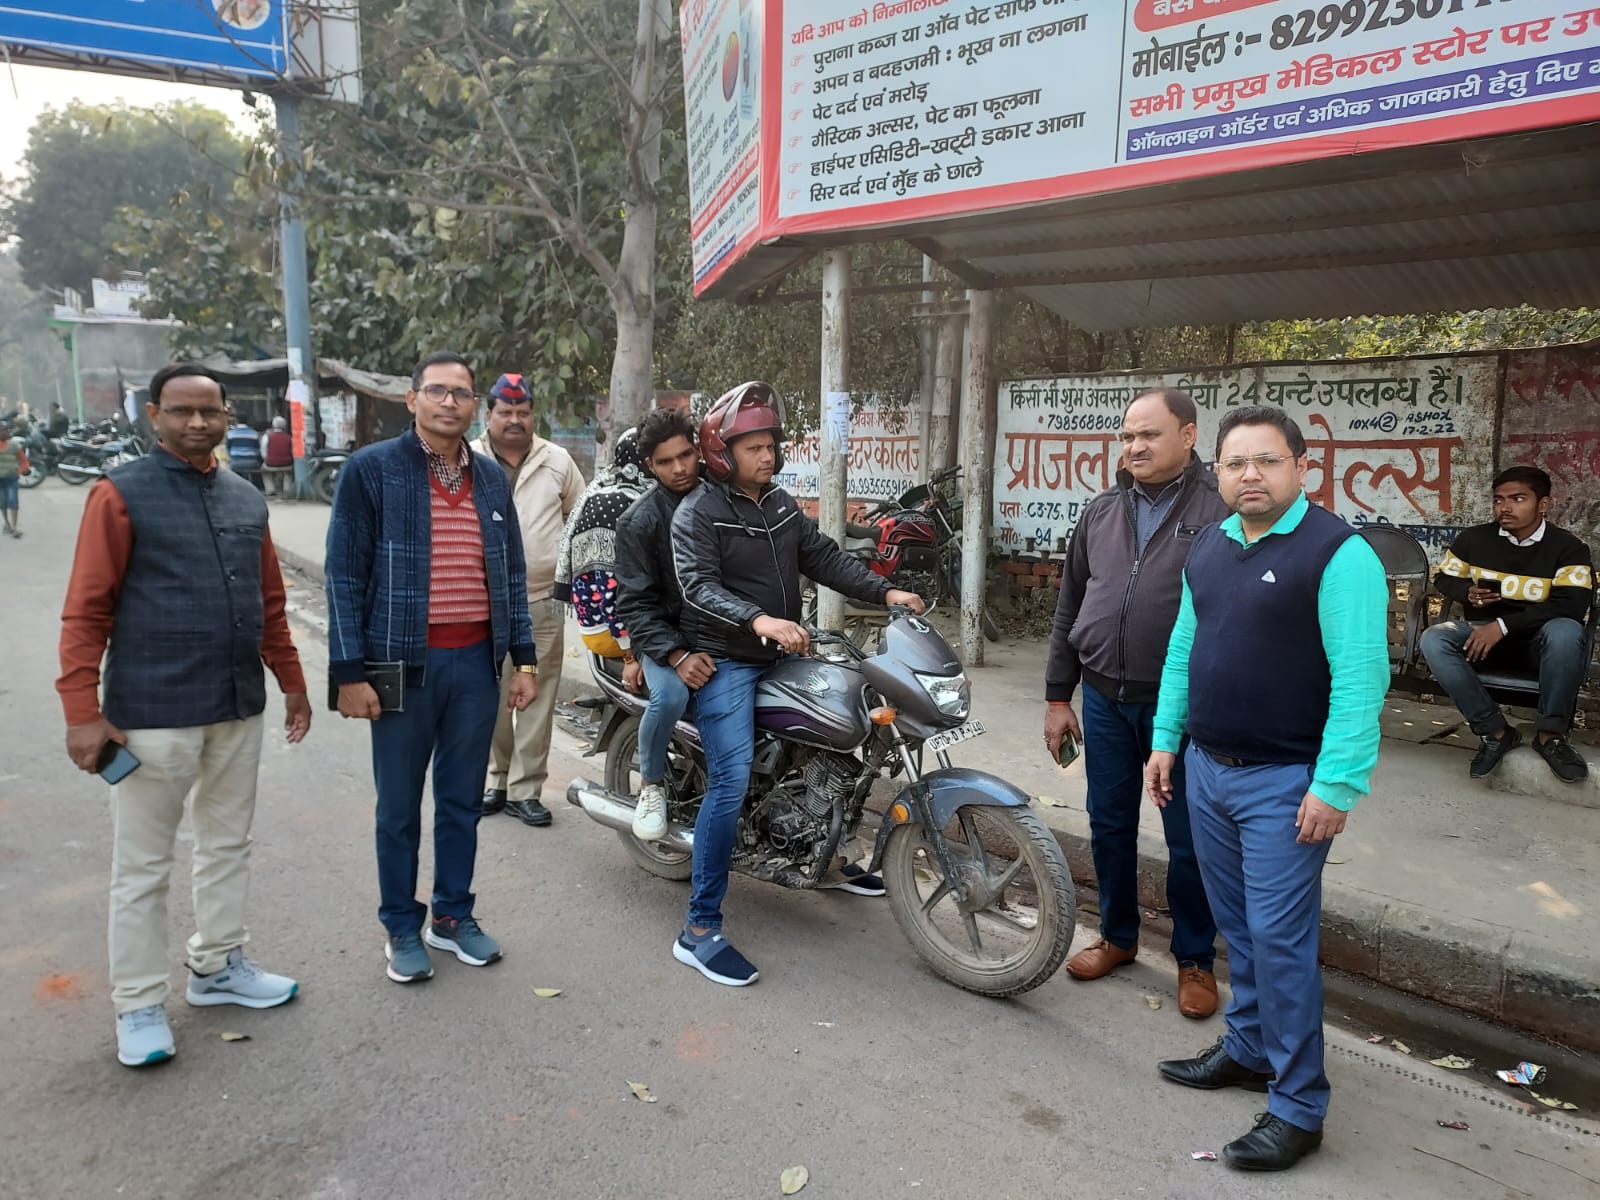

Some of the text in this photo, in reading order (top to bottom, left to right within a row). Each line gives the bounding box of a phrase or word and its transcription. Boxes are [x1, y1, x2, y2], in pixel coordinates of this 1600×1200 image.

[791, 23, 815, 45] यदि
[818, 18, 845, 38] आप
[849, 8, 867, 28] को
[813, 43, 854, 74] पुराना
[858, 32, 897, 54] कब्ज
[902, 25, 921, 43] या
[965, 6, 991, 26] पेट
[813, 72, 850, 95] अपच
[853, 69, 865, 83] व
[868, 45, 942, 80] बदहजमी
[957, 36, 995, 66] भूख
[999, 30, 1022, 48] ना
[1026, 13, 1088, 44] लगना
[1132, 23, 1230, 78] मोबाईल
[1129, 82, 1186, 118] सभी
[1191, 73, 1270, 112] प्रमुख
[1276, 46, 1407, 90] मेडिकल
[1412, 26, 1494, 66] स्टोर
[1500, 16, 1556, 46] पर
[812, 80, 930, 121] पेट दर्द एवं मरोड़
[925, 105, 950, 125] पेट
[953, 101, 978, 119] का
[983, 88, 1042, 120] फूलना
[1130, 126, 1217, 151] ऑनलाइन
[1218, 112, 1270, 138] ऑर्डर
[1273, 105, 1306, 129] एवं
[1305, 98, 1375, 124] अधिक
[1378, 74, 1483, 112] जानकारी
[1488, 69, 1530, 98] हेतु
[1535, 60, 1583, 86] दिए
[810, 153, 857, 177] हाईपर
[981, 121, 1033, 146] डकार
[1036, 111, 1086, 135] आना
[810, 182, 836, 202] सिर
[839, 175, 863, 197] दर्द
[866, 171, 890, 194] एवं
[923, 162, 942, 183] के
[946, 155, 984, 180] छाले
[1009, 383, 1042, 410] किसी
[1226, 381, 1261, 407] 24
[1317, 377, 1421, 408] उपलब्ध
[1004, 432, 1118, 493] प्राजल
